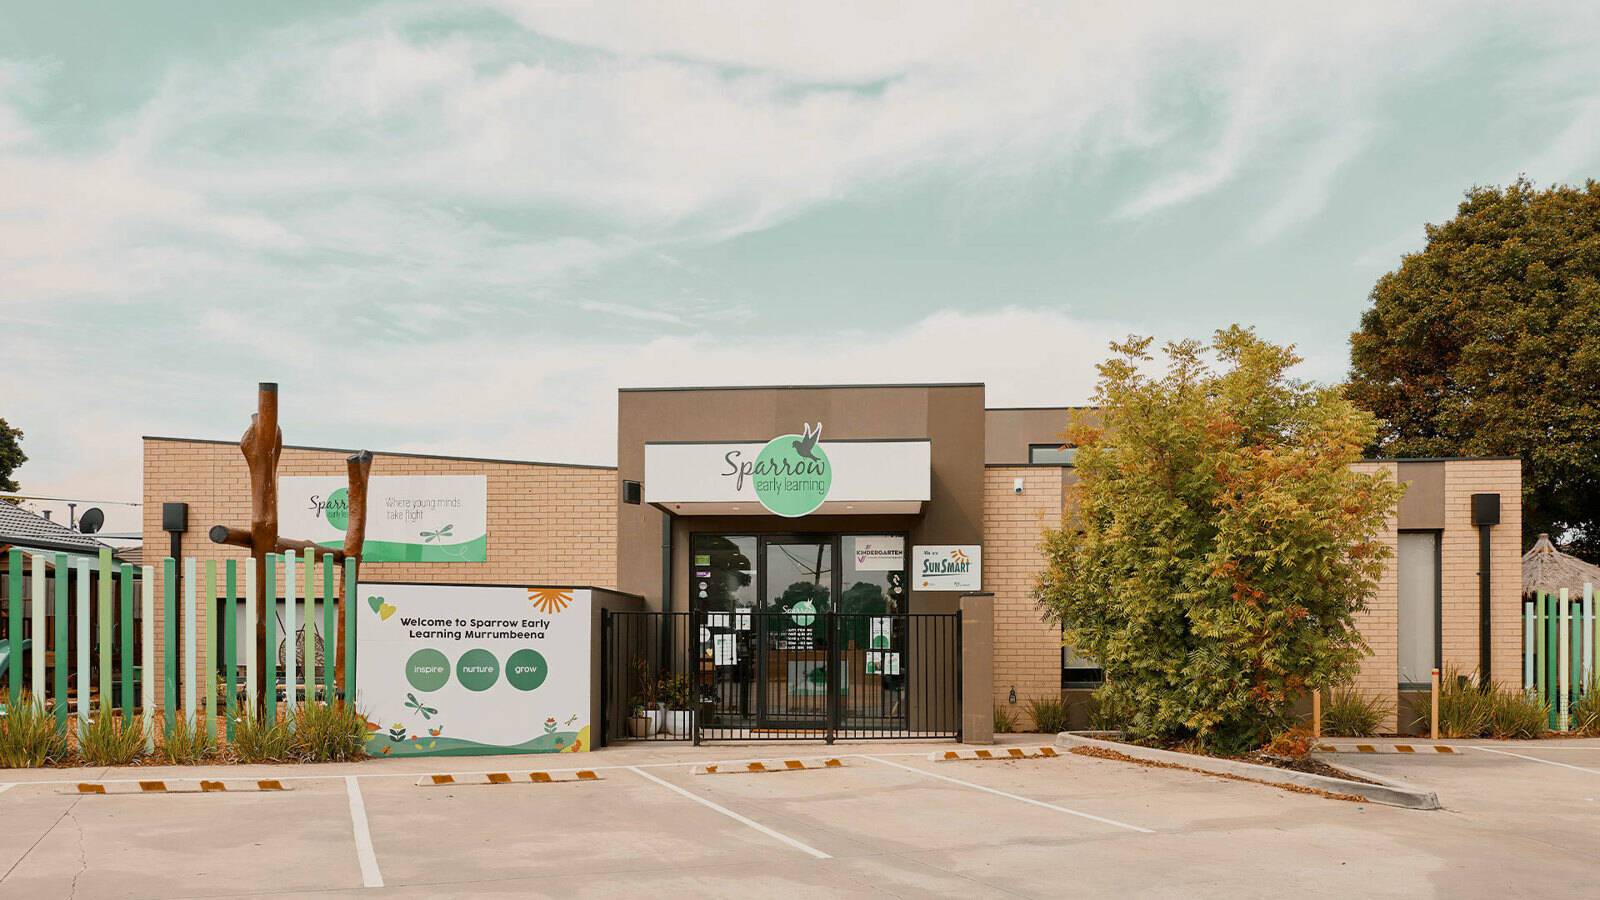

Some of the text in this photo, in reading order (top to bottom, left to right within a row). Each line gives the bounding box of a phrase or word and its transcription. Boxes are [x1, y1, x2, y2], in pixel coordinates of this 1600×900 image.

[721, 450, 825, 492] Sparrow
[757, 477, 824, 495] early learning
[385, 496, 461, 511] Where young minds
[387, 508, 424, 523] take flight
[400, 617, 550, 630] Welcome to Sparrow Early
[409, 629, 545, 640] Learning Murrumbeena
[414, 666, 444, 674] inspire
